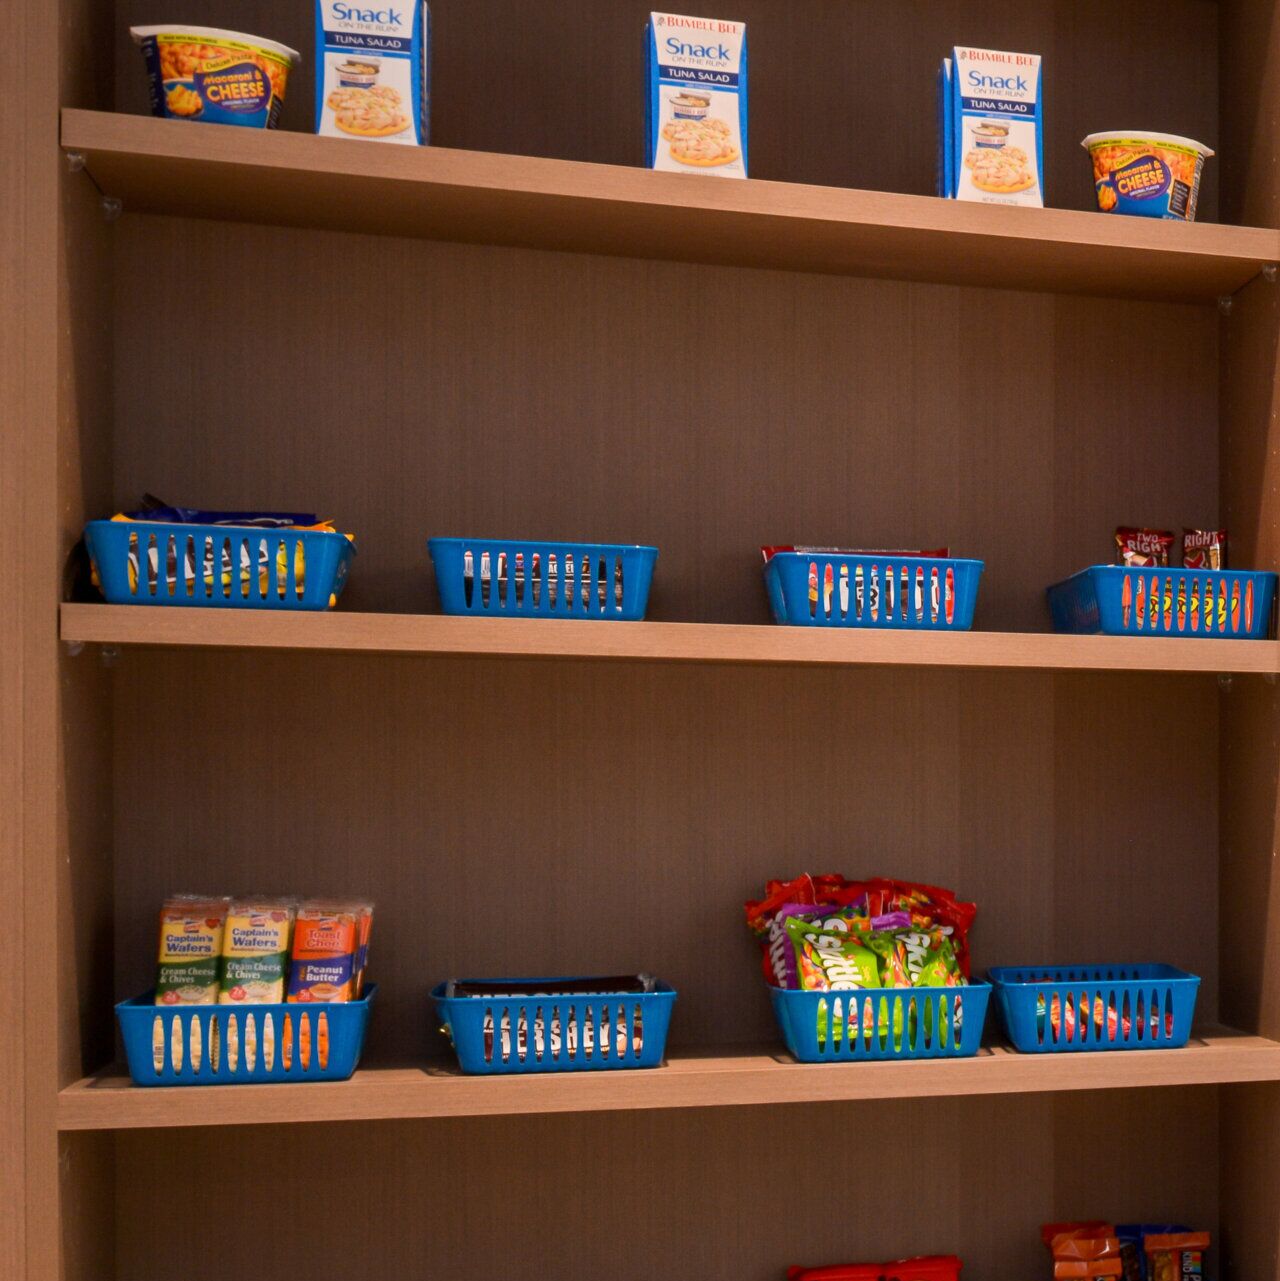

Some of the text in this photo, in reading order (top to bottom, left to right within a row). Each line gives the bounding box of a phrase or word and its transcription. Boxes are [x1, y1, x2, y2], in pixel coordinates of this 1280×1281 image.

[332, 3, 402, 26] Snack
[334, 34, 402, 49] TUNA SALAD
[666, 38, 730, 61] Snack
[968, 50, 1013, 64] BUMBLE
[669, 68, 730, 83] TUNA SALAD
[968, 70, 1027, 91] Snack
[206, 81, 264, 101] CHEESE
[970, 99, 1027, 113] TUNA SALAD
[1117, 171, 1164, 193] CHEESE
[1137, 533, 1158, 543] TWO
[1184, 531, 1218, 547] RIGHT
[232, 928, 279, 938] Captain's
[166, 934, 213, 945] Captain's
[233, 937, 277, 947] Wafers
[166, 944, 211, 953] Wafers
[161, 967, 216, 976] Cream Cheese
[227, 962, 281, 971] Cream Cheese
[307, 966, 343, 975] Peanut
[168, 975, 195, 983] Chives
[235, 971, 260, 979] Chives
[306, 973, 339, 982] Butter
